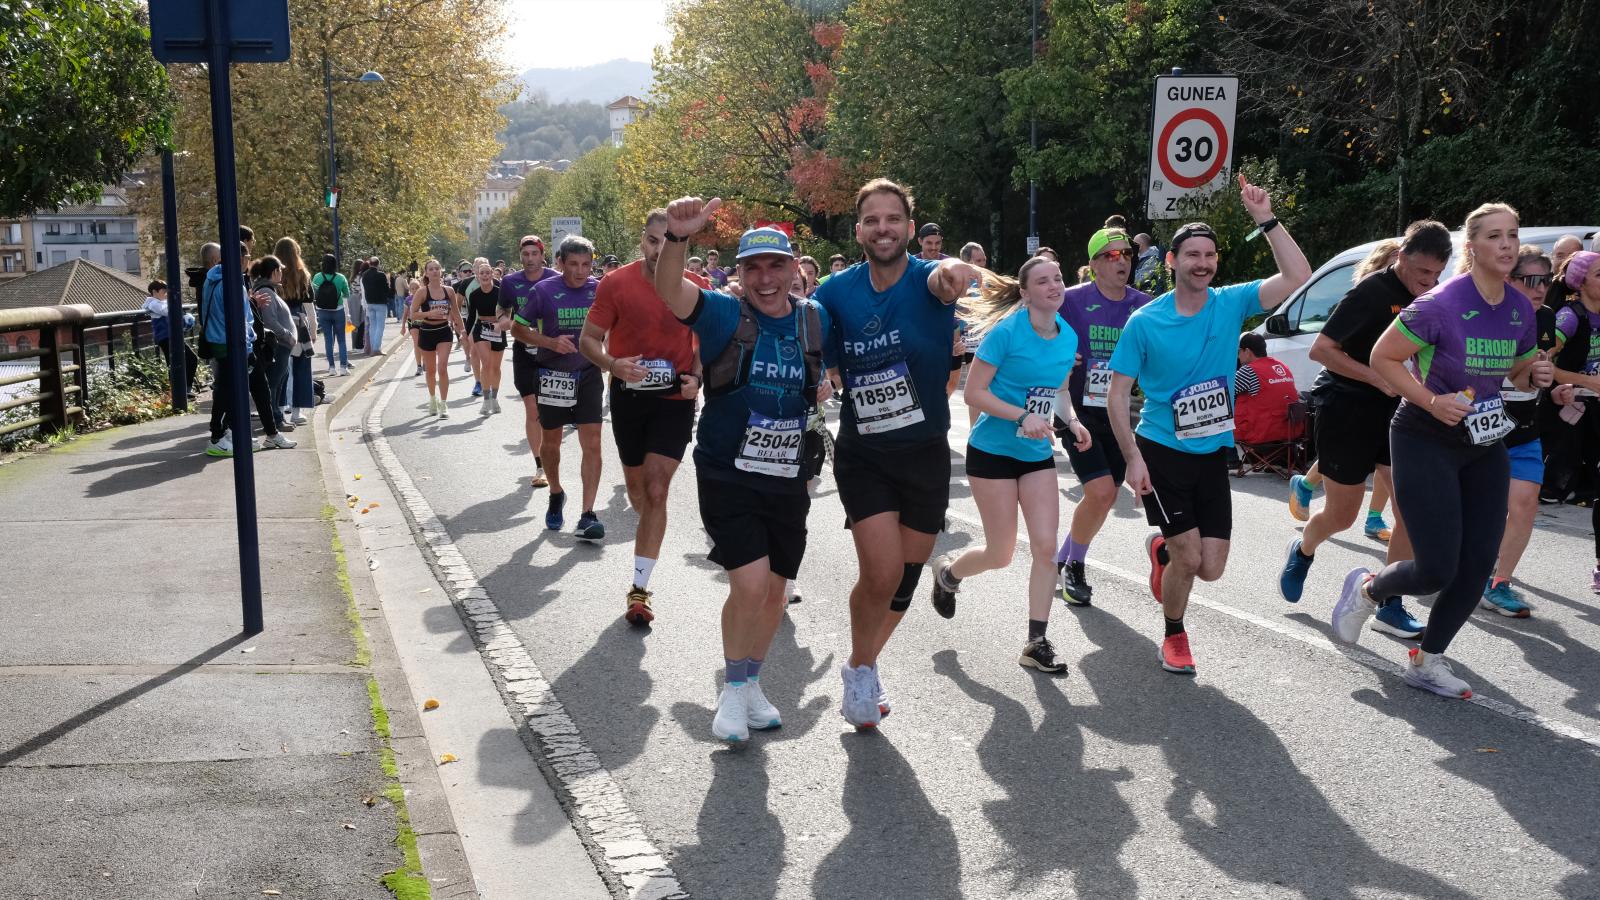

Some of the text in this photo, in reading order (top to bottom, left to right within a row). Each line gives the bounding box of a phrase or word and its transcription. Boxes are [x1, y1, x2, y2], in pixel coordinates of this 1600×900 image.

[1167, 86, 1226, 101] GUNEA
[1175, 136, 1213, 162] 30
[747, 235, 780, 246] HOKA
[843, 329, 901, 356] FRIME
[752, 360, 803, 380] FRIM
[1465, 356, 1484, 368] SAN
[541, 378, 574, 391] 21793
[855, 381, 908, 407] 18595
[1178, 392, 1225, 416] 21020
[748, 431, 800, 449] 25042
